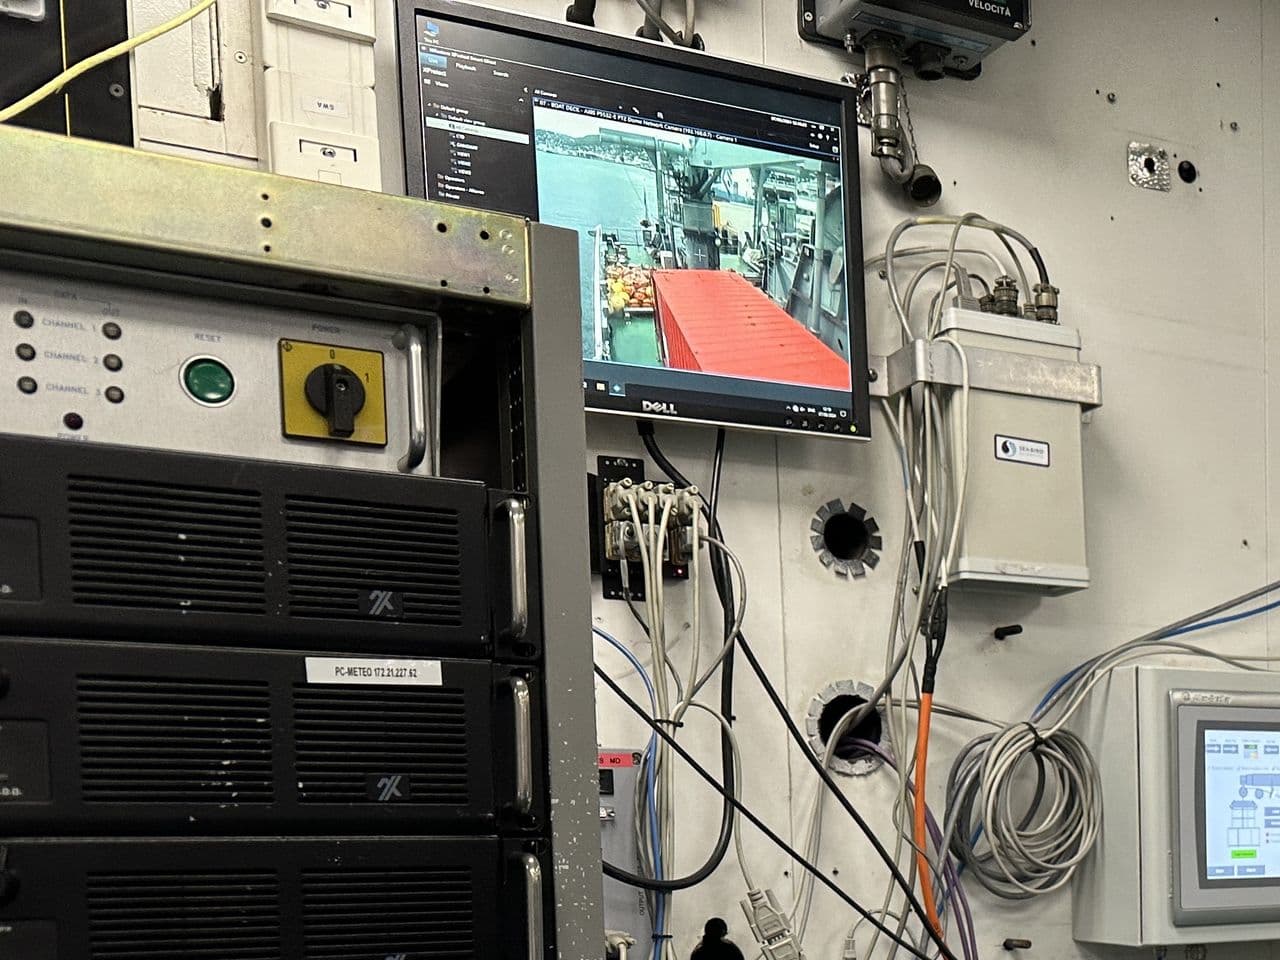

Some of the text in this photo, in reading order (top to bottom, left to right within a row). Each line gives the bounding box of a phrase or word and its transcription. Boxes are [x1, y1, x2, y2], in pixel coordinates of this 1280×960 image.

[42, 318, 85, 331] CHANNEL
[194, 333, 222, 343] RESET
[44, 351, 87, 363] CHANNEL
[330, 349, 336, 360] 0
[364, 373, 370, 384] 1
[46, 384, 89, 396] CHANNEL
[642, 400, 677, 415] DELL
[335, 666, 417, 678] PC-METEO 172.21.227.62
